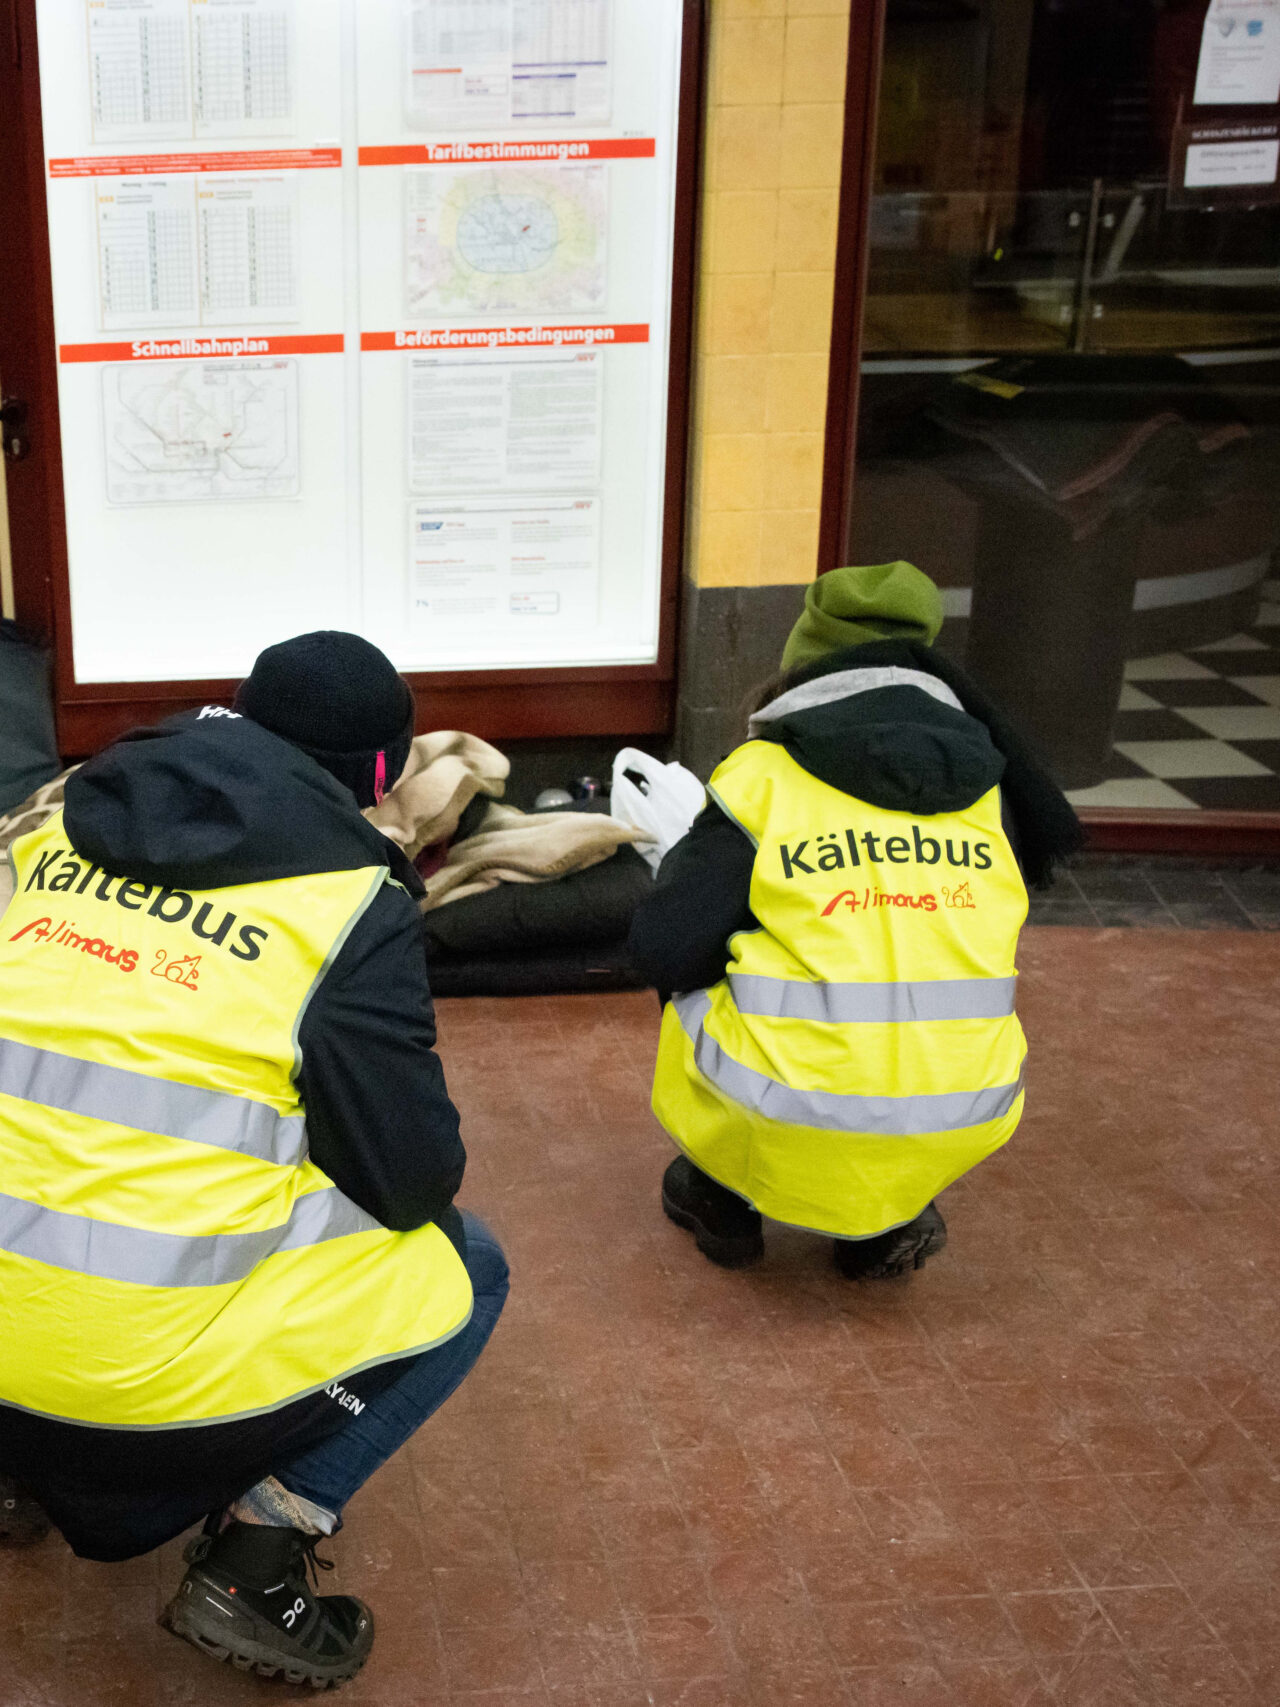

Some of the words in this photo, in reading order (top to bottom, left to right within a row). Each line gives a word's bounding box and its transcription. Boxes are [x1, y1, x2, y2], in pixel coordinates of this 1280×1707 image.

[425, 142, 590, 161] Tarifbestimmungen
[131, 338, 269, 357] Schnellbahnplan
[394, 327, 615, 347] Beförderungsbedingungen
[779, 824, 993, 879] Kältebus
[24, 849, 269, 962] Kältebus
[820, 886, 938, 917] Alimaus
[8, 916, 140, 973] Alimaus
